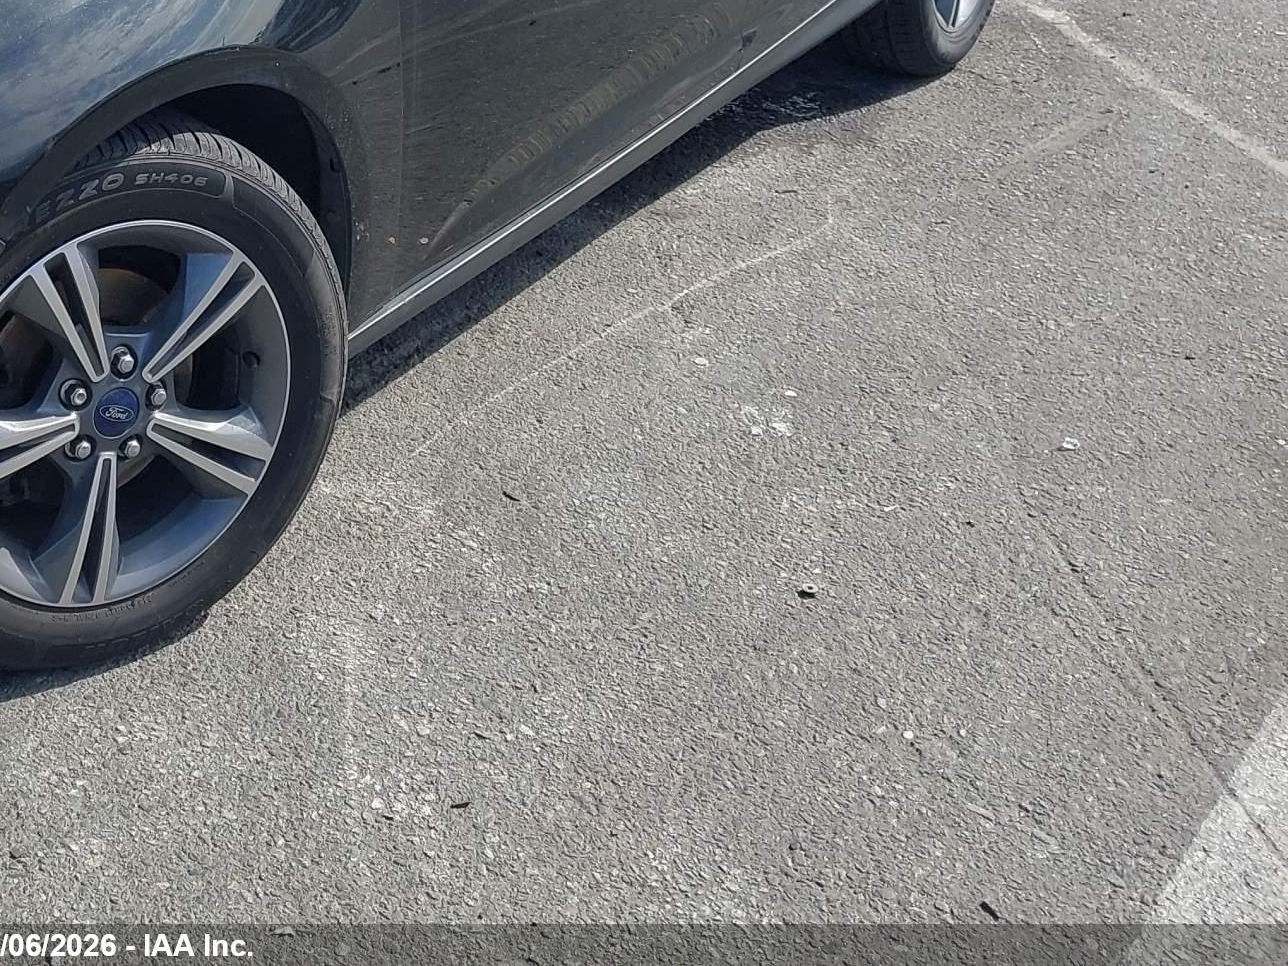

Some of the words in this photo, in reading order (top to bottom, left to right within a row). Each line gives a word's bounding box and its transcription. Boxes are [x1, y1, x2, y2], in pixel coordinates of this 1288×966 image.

[33, 172, 124, 226] EZZO
[134, 171, 209, 187] SH406
[105, 406, 129, 420] Ford
